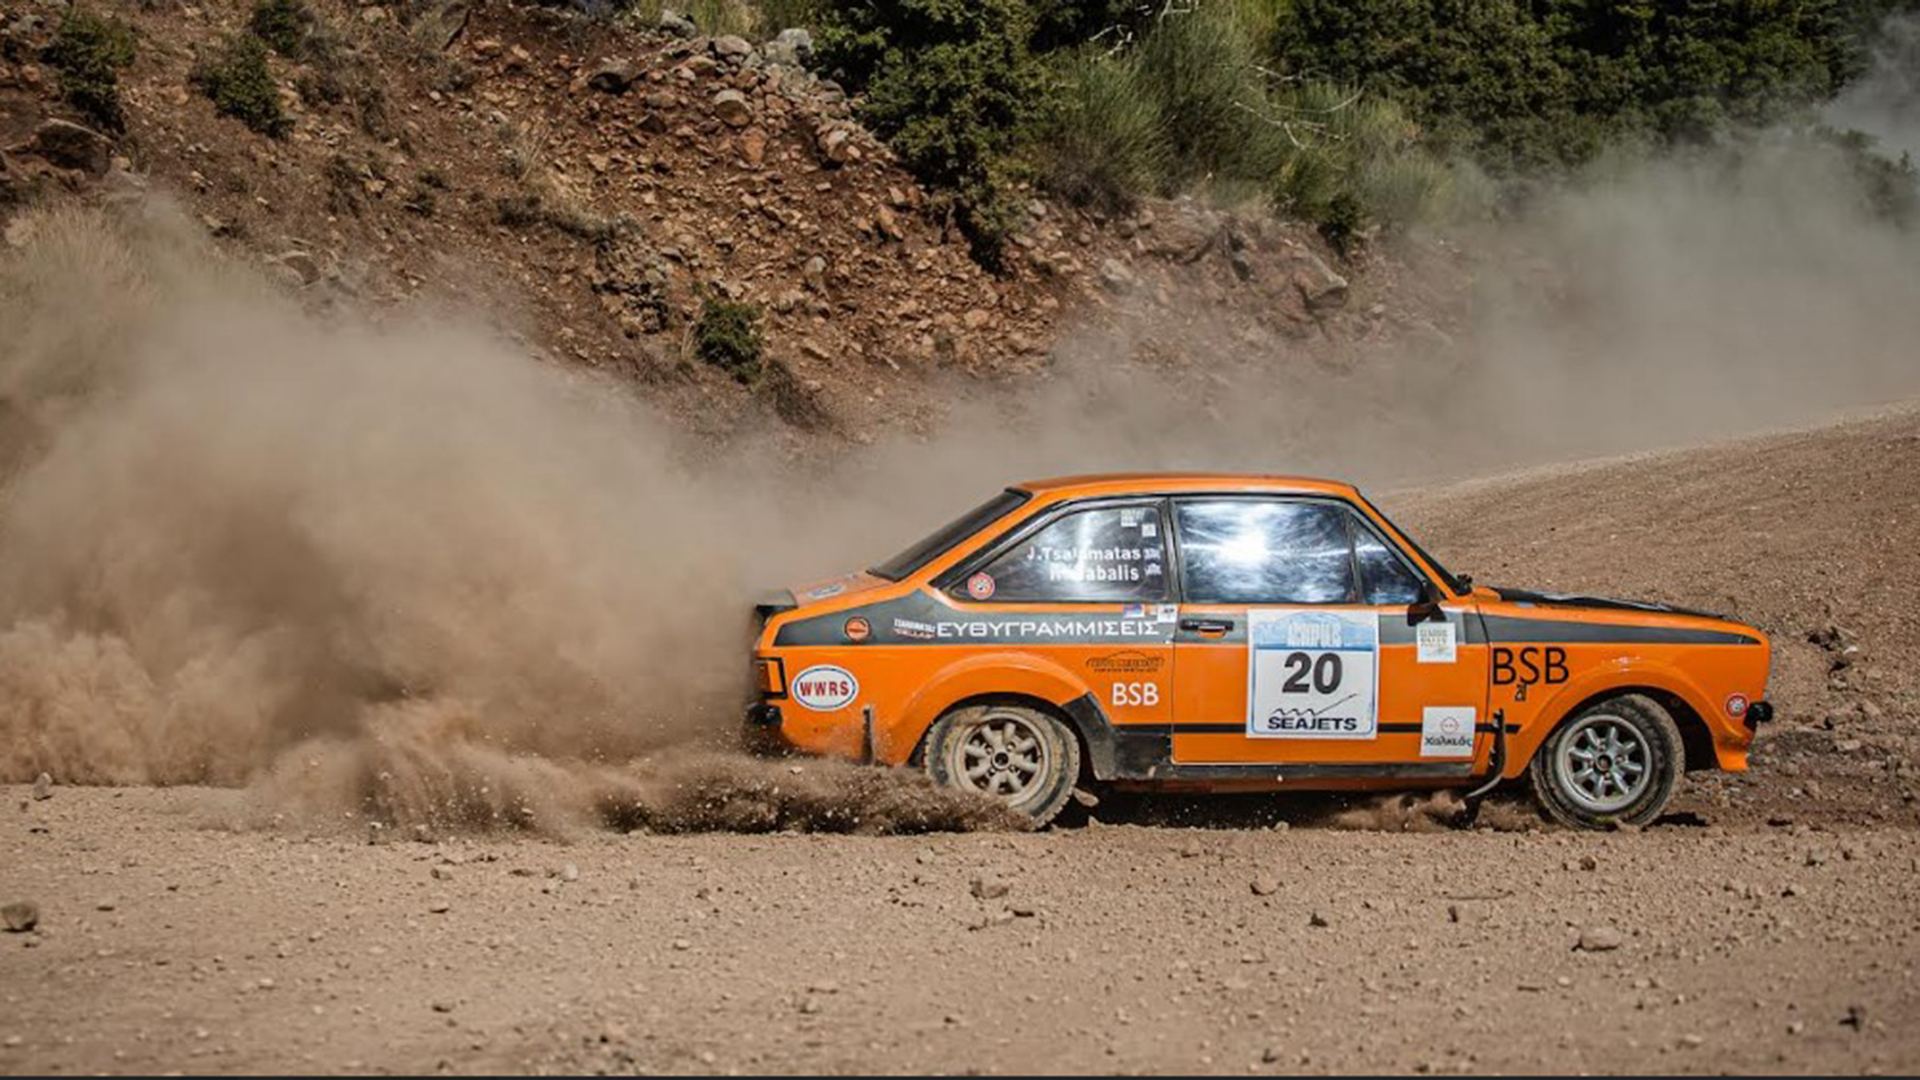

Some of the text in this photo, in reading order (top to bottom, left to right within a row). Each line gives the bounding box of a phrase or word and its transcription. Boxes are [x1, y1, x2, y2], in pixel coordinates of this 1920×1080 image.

[1282, 651, 1343, 694] 20
[1493, 646, 1569, 684] BSB
[800, 681, 849, 696] WWRS
[1112, 682, 1159, 706] BSB
[1268, 716, 1357, 731] SEAJETS
